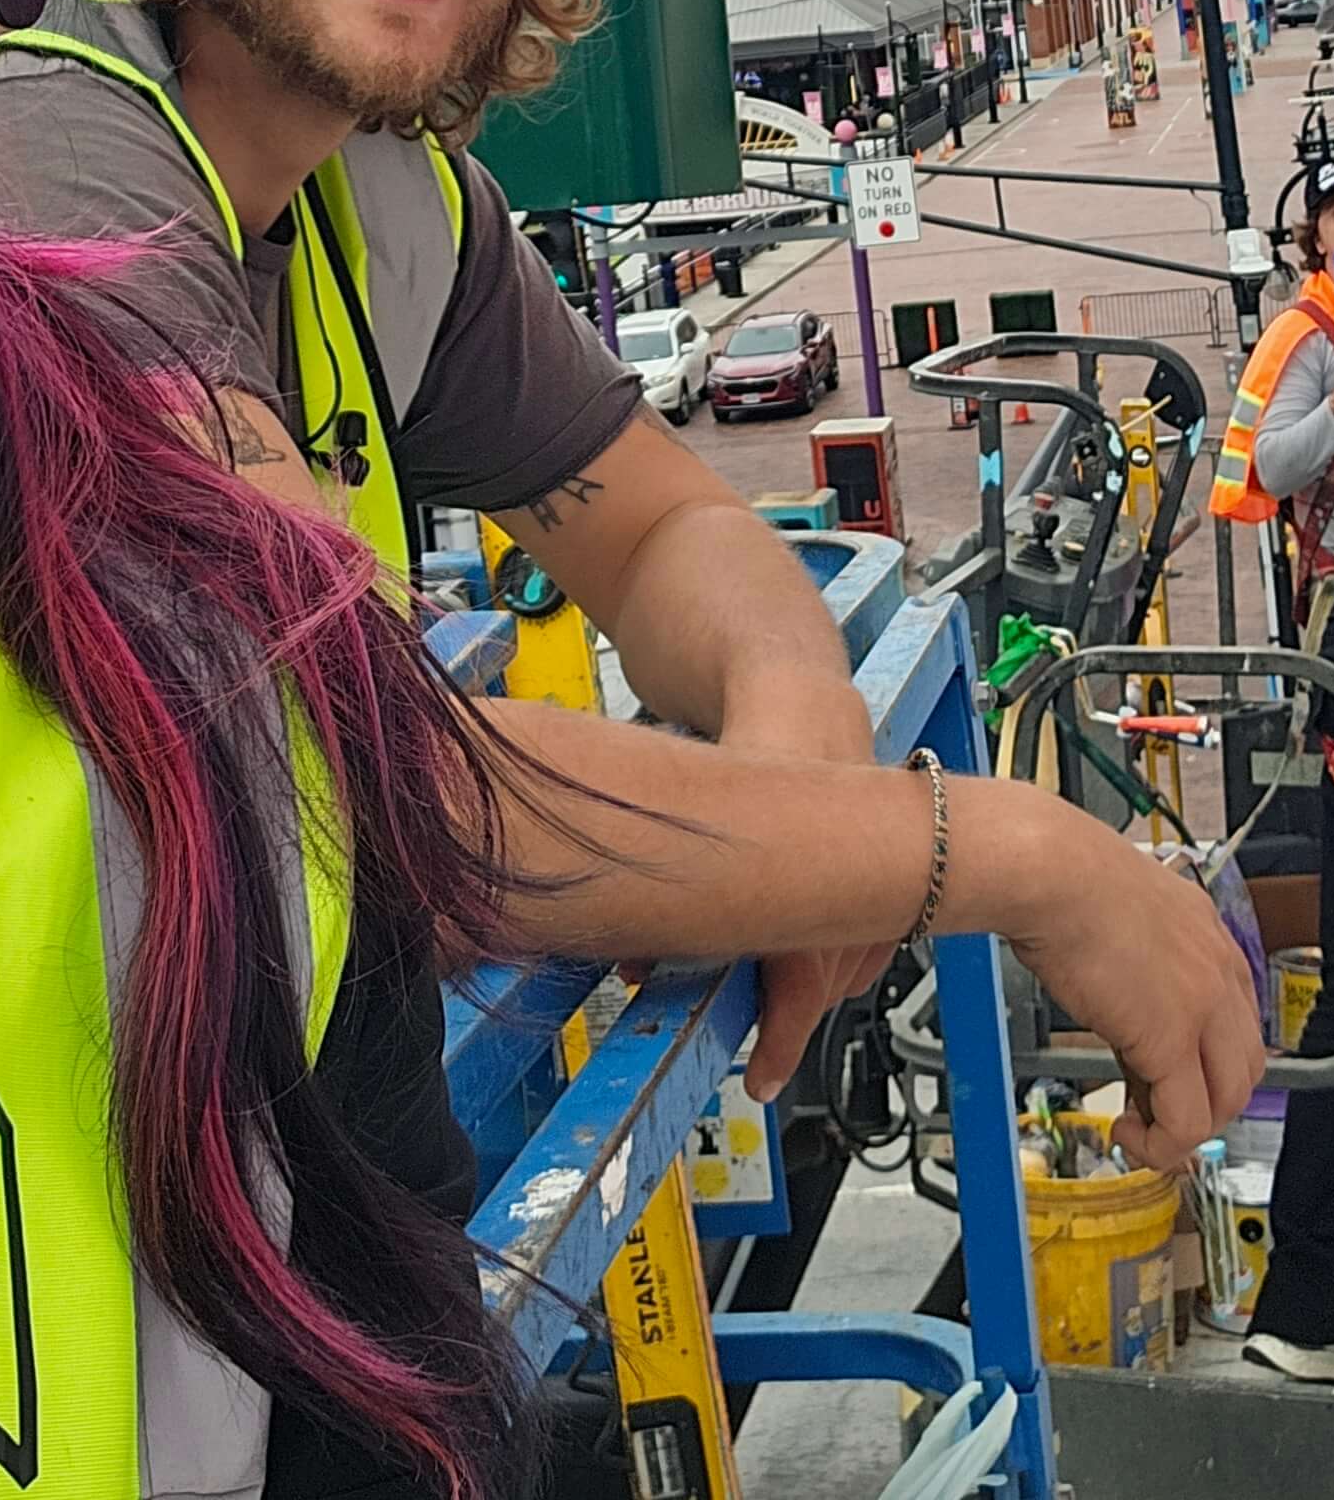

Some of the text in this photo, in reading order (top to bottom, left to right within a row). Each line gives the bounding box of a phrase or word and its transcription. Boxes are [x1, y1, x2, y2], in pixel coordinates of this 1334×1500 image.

[1110, 111, 1132, 125] ATL
[866, 166, 894, 184] NO
[864, 185, 902, 201] TURN
[858, 202, 912, 219] ON RED
[625, 1225, 663, 1345] STANLE
